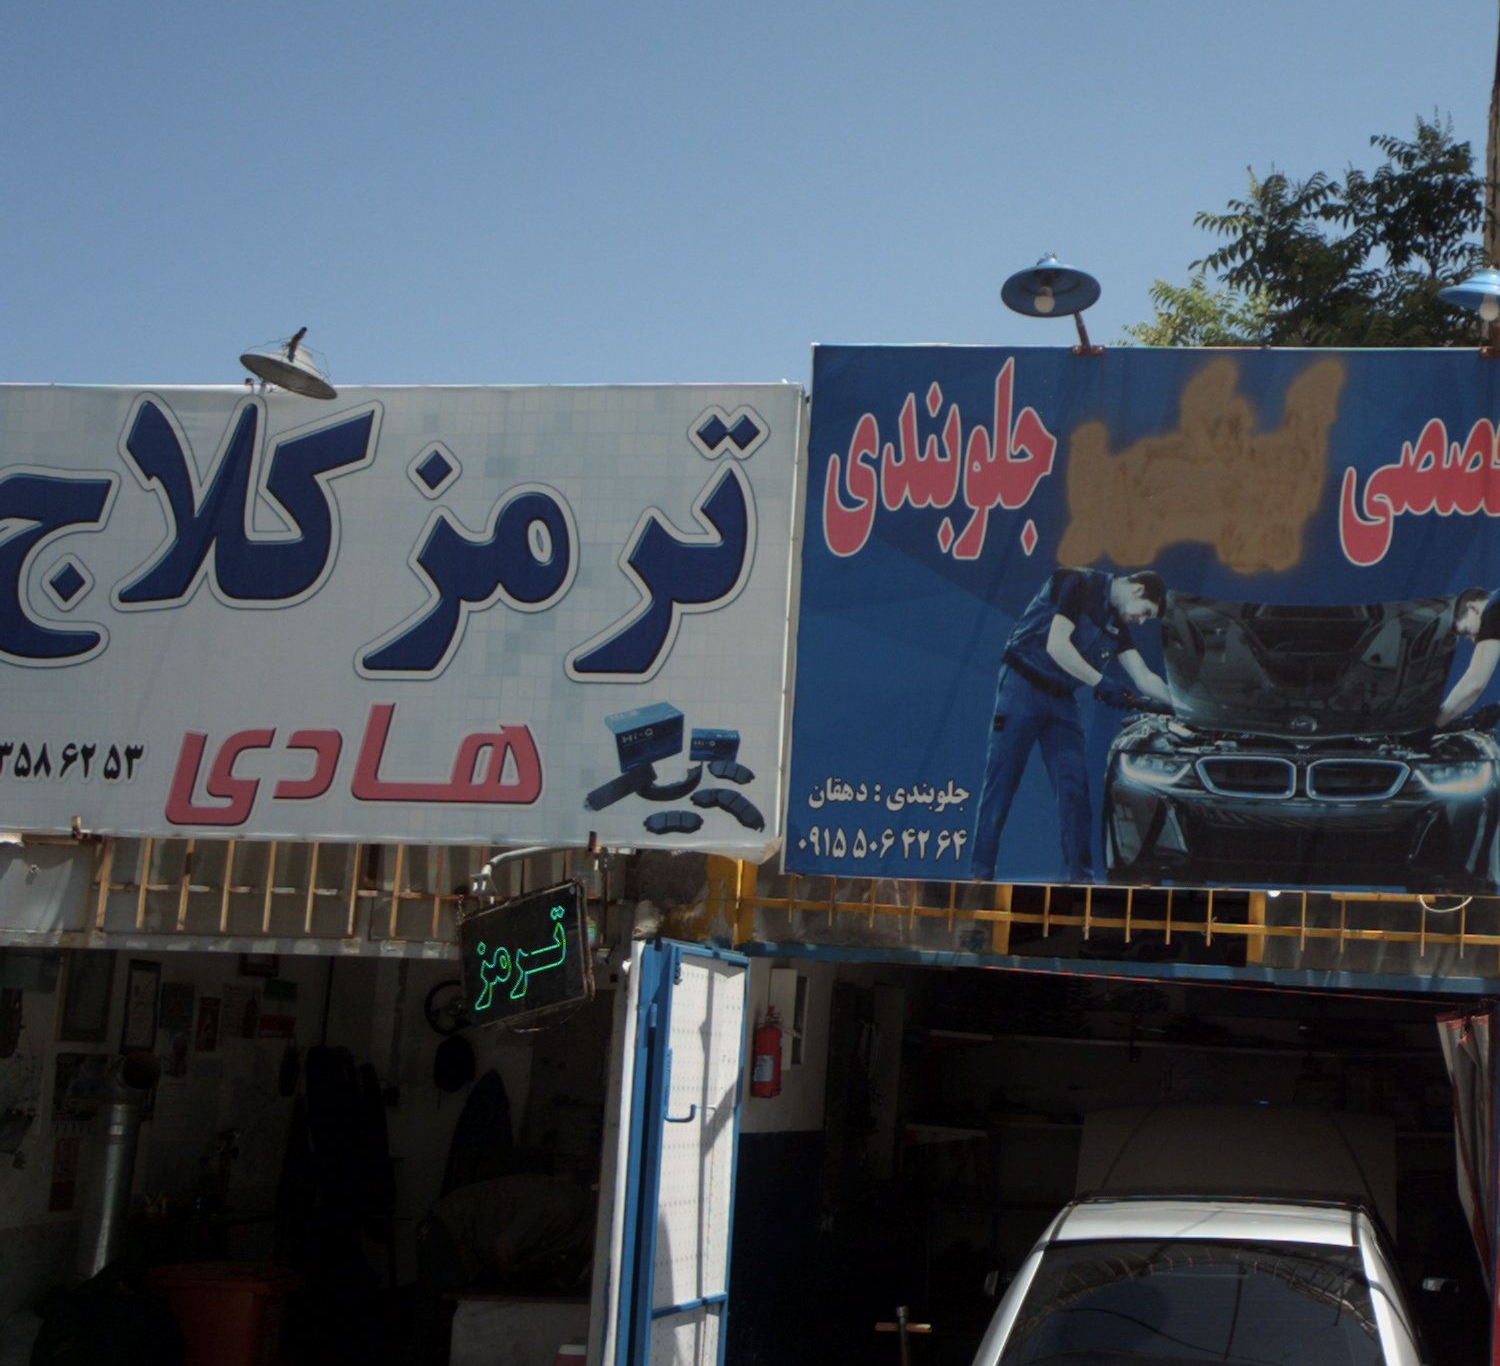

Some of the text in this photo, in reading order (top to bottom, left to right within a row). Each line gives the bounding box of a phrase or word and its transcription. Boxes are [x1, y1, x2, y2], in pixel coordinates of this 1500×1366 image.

[823, 356, 1058, 560] جلوبندی
[360, 409, 766, 676] ترمز
[165, 702, 542, 826] هادی
[808, 776, 867, 809] دهقان
[474, 905, 566, 1011] ترمز
